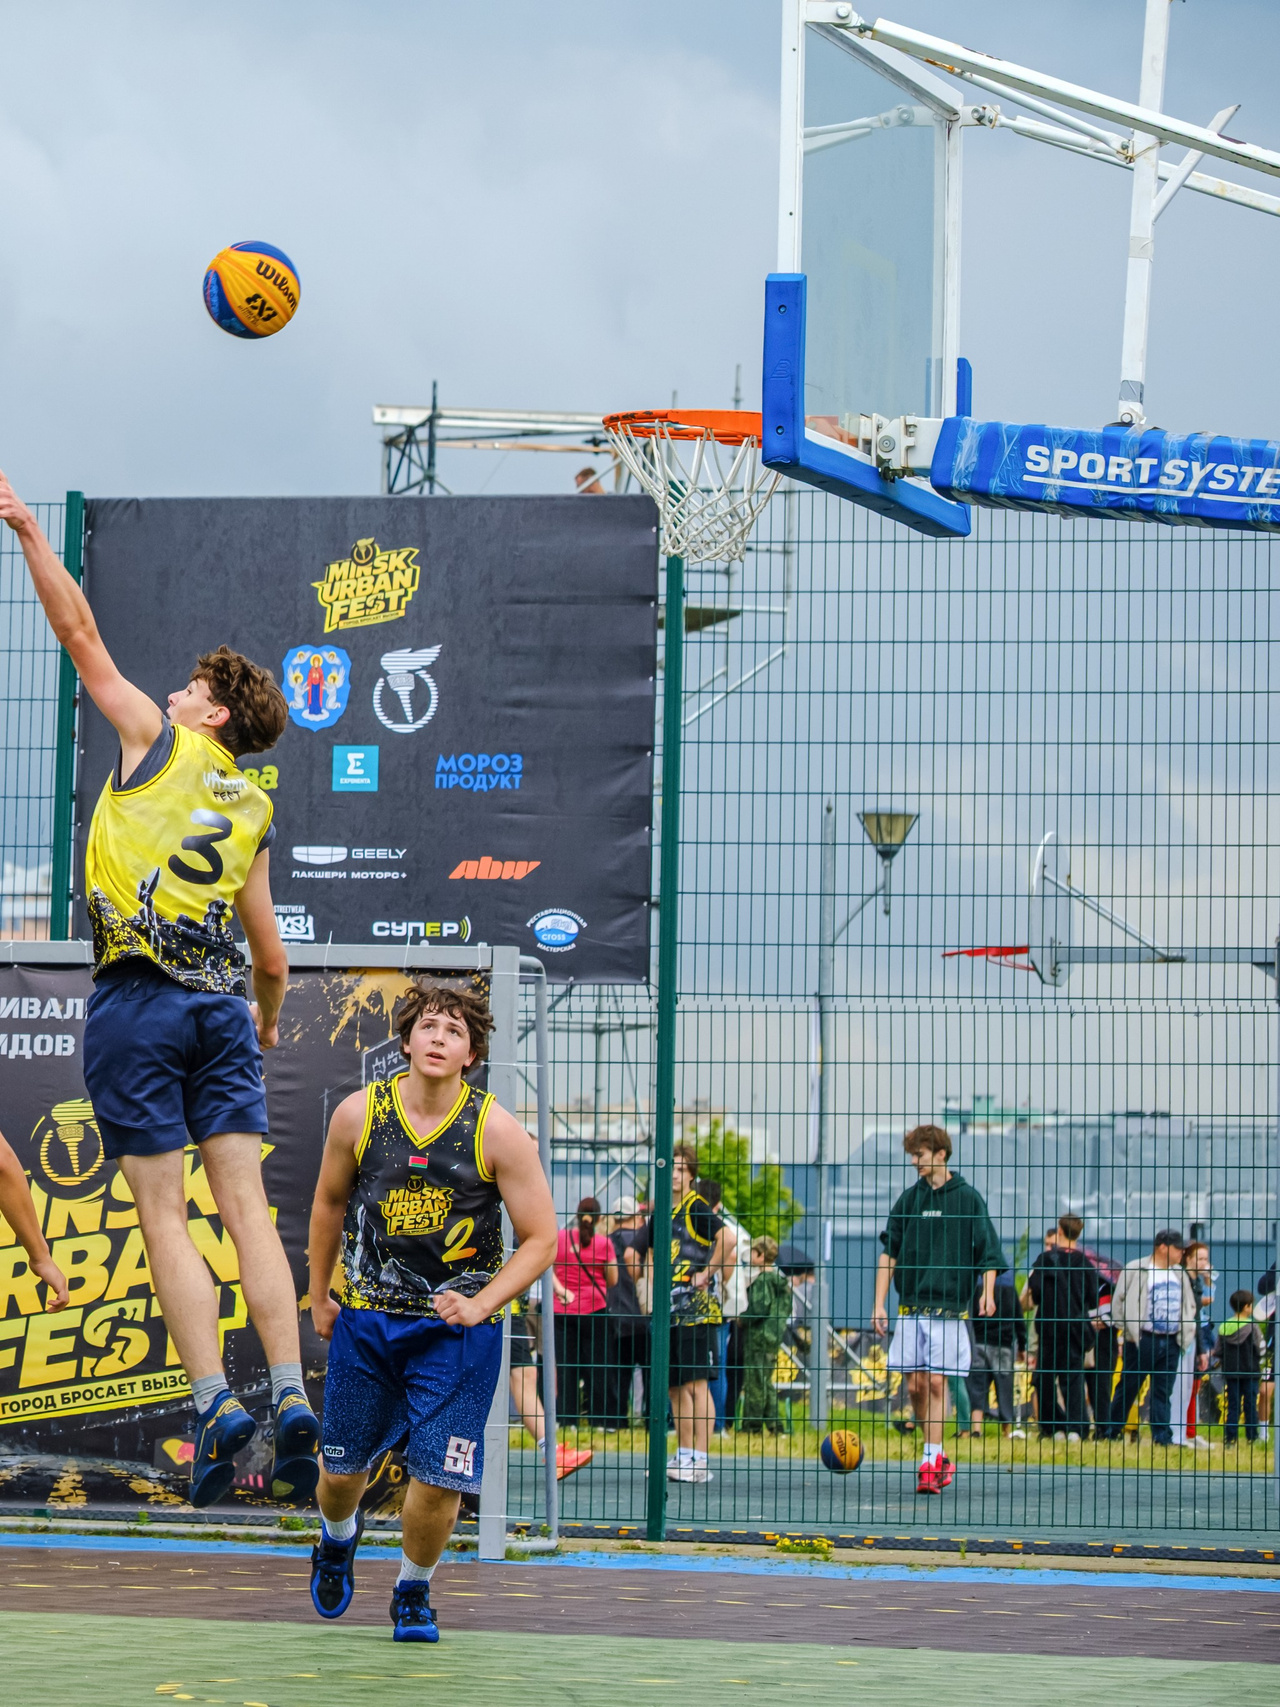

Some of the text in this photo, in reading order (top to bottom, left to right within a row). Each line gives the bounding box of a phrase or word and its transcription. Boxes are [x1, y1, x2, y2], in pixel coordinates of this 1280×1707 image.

[1025, 444, 1158, 484] SPORT
[328, 550, 411, 583] MINSK
[322, 568, 413, 603] URBAN
[330, 588, 405, 626] FEST
[436, 753, 523, 773] МОРОЗ
[435, 773, 523, 792] ПРОДУКТ
[168, 808, 233, 885] 3
[351, 848, 407, 859] GEELY
[292, 870, 347, 879] ЛАКШЕРИ
[372, 921, 459, 937] СУПЕР
[388, 1187, 447, 1203] MINSK
[384, 1199, 447, 1217] URBAN
[390, 1210, 443, 1233] FEST
[441, 1217, 477, 1262] 2
[1, 1374, 190, 1415] ГОРОД БРОСАЕТ ВЫЗО
